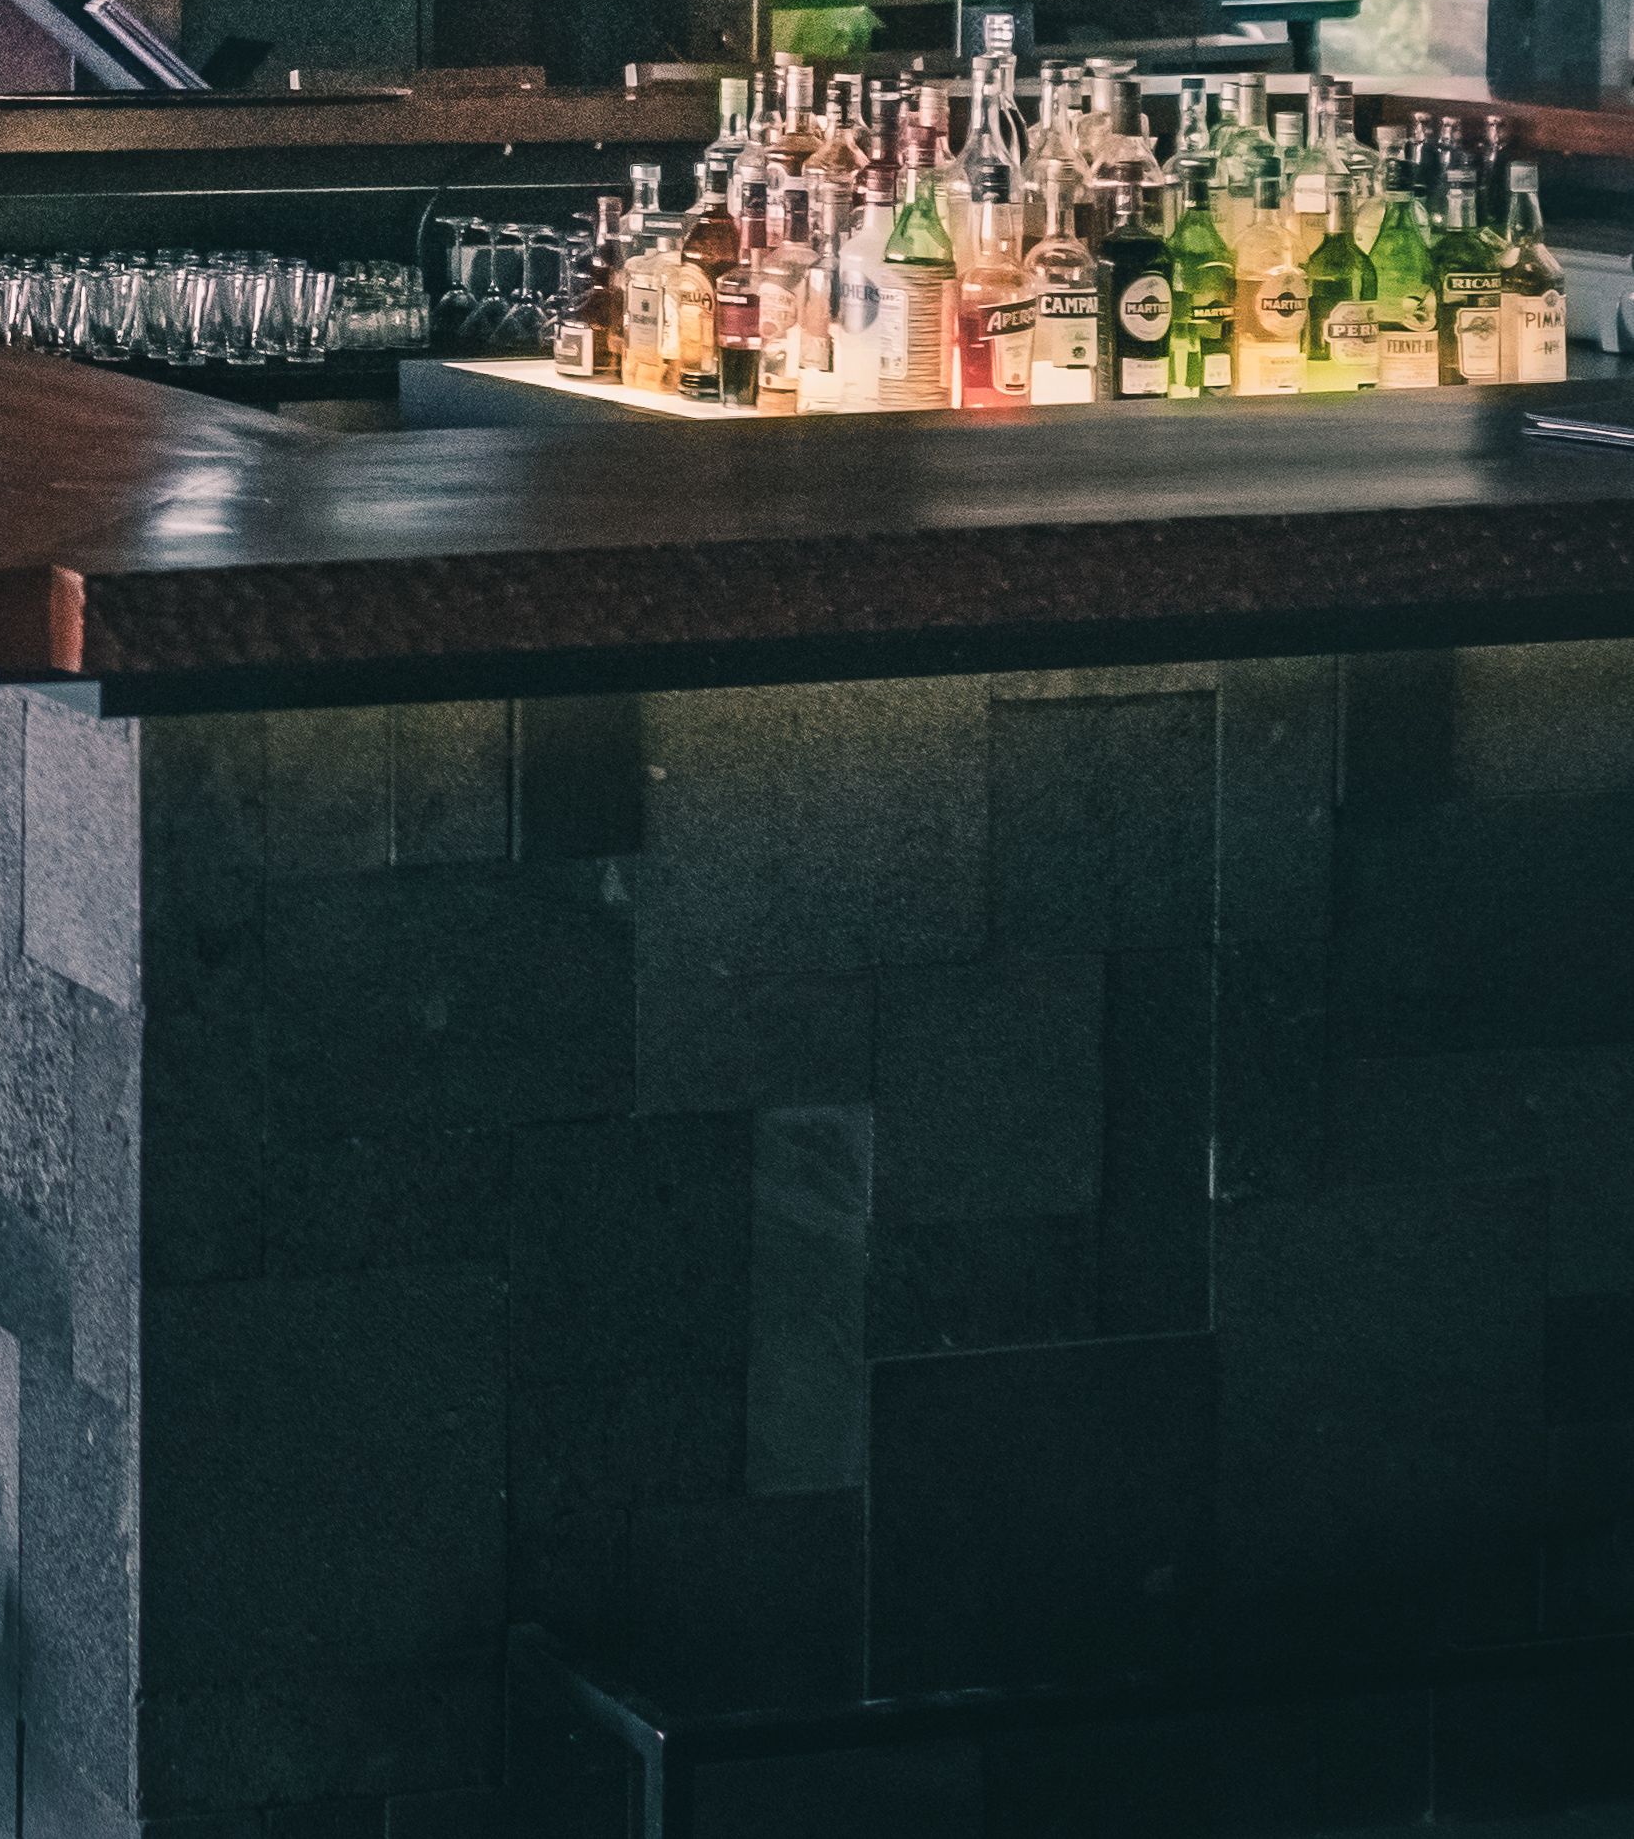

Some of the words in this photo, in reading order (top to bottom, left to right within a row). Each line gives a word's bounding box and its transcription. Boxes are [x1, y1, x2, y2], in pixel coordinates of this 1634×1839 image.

[1041, 296, 1099, 314] CAMPA
[987, 307, 1035, 333] APERO
[1331, 324, 1379, 338] PERN
